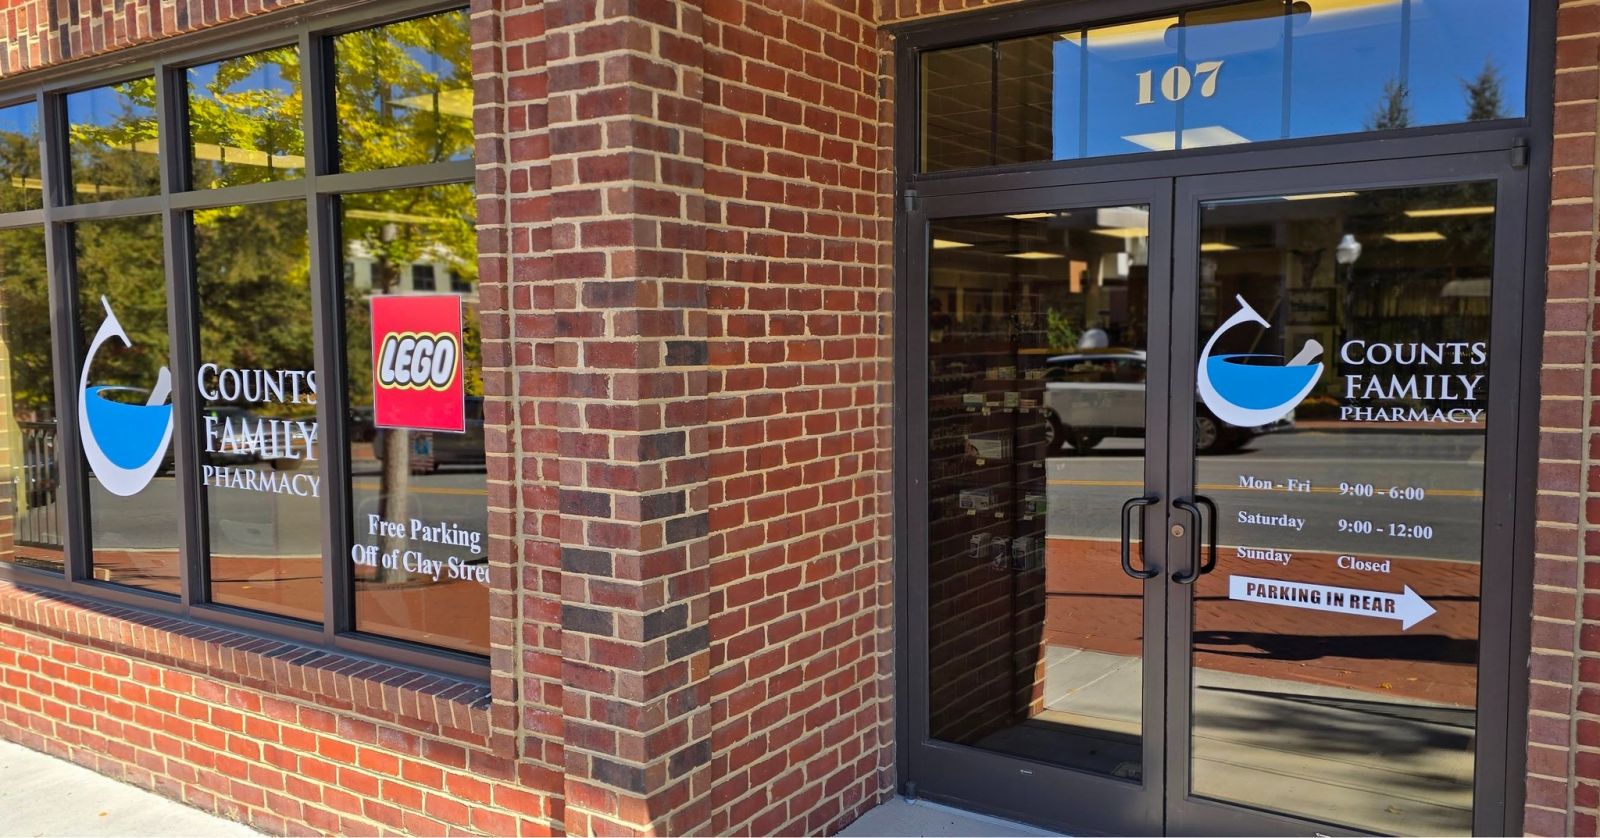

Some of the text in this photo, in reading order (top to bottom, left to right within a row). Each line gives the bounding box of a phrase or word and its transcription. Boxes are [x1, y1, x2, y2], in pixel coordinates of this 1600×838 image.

[1136, 60, 1224, 105] 107
[380, 335, 457, 388] LEGO
[1341, 340, 1487, 365] COUNTS
[1345, 374, 1485, 400] FAMILY
[1340, 406, 1484, 423] PHARMACY
[203, 416, 318, 461] FAMILY
[202, 464, 320, 498] PHARMACY
[1239, 475, 1272, 490] Mon
[1288, 478, 1311, 493] Fri
[1339, 482, 1374, 497] 9:00
[1389, 486, 1425, 501] 6:00
[1238, 510, 1305, 531] Saturday
[1338, 519, 1372, 534] 9:00
[1389, 523, 1433, 540] 12:00
[368, 513, 481, 554] Free Parking
[351, 543, 379, 567] Off
[382, 549, 399, 570] of
[402, 550, 442, 582] Clay
[1237, 546, 1292, 566] Sunday
[1337, 555, 1391, 573] Closed
[1246, 582, 1396, 614] PARKING IN REAR
